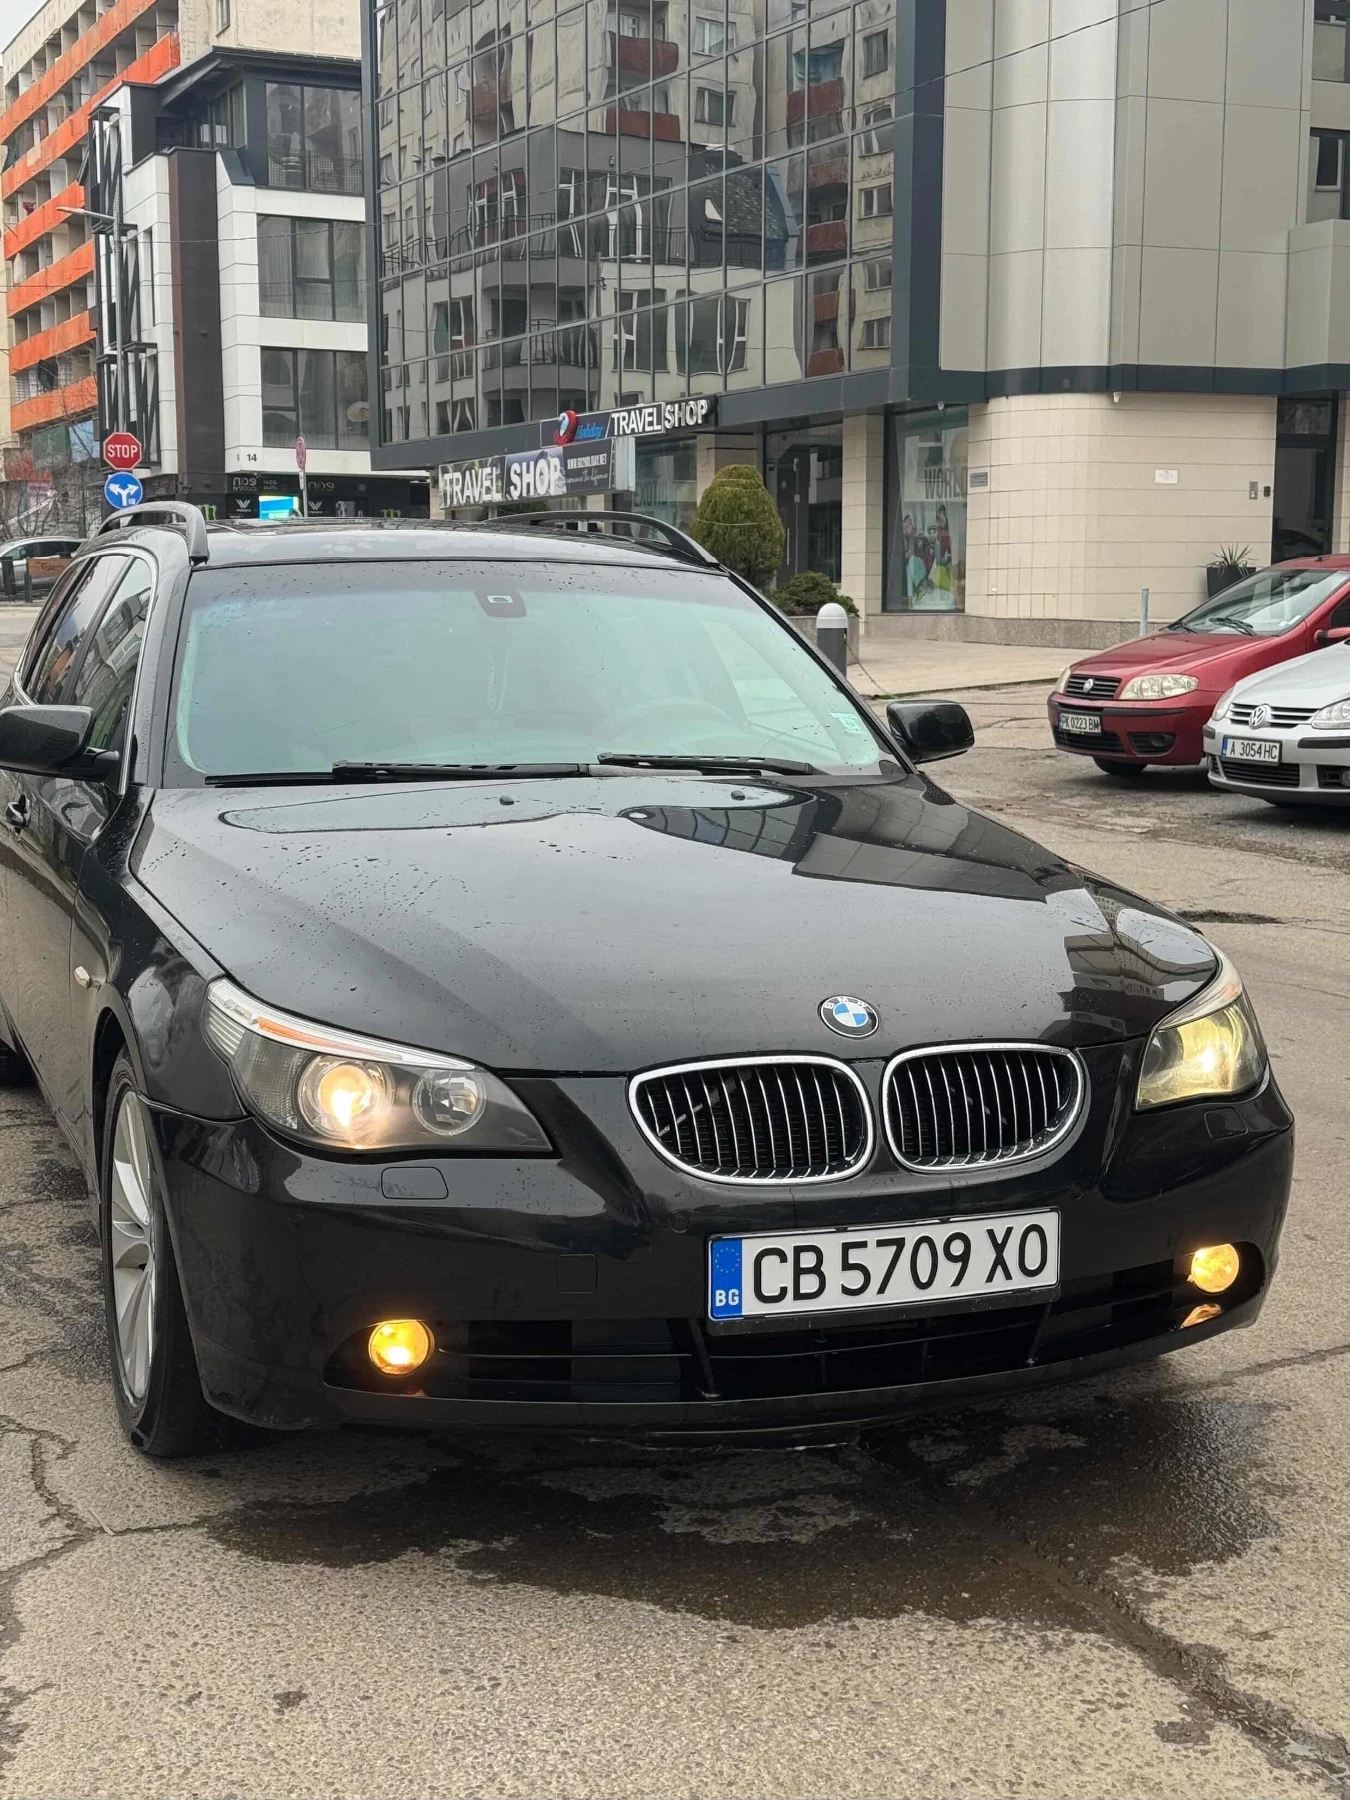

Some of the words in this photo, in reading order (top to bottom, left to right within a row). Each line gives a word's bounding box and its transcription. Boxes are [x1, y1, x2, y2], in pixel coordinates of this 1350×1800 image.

[612, 407, 662, 436] TRAVEL
[664, 400, 708, 429] SHOP
[107, 444, 138, 458] STOP
[247, 453, 257, 462] 14
[443, 466, 502, 508] TRAVEL
[510, 457, 561, 500] SHOP
[1070, 717, 1088, 730] 0223
[1230, 741, 1236, 756] A
[1239, 742, 1262, 758] 3054
[1263, 744, 1278, 760] HC
[824, 996, 869, 1010] BMW
[753, 1244, 827, 1304] CB
[840, 1231, 972, 1297] 5709
[984, 1223, 1048, 1283] XO
[714, 1288, 740, 1307] BG
